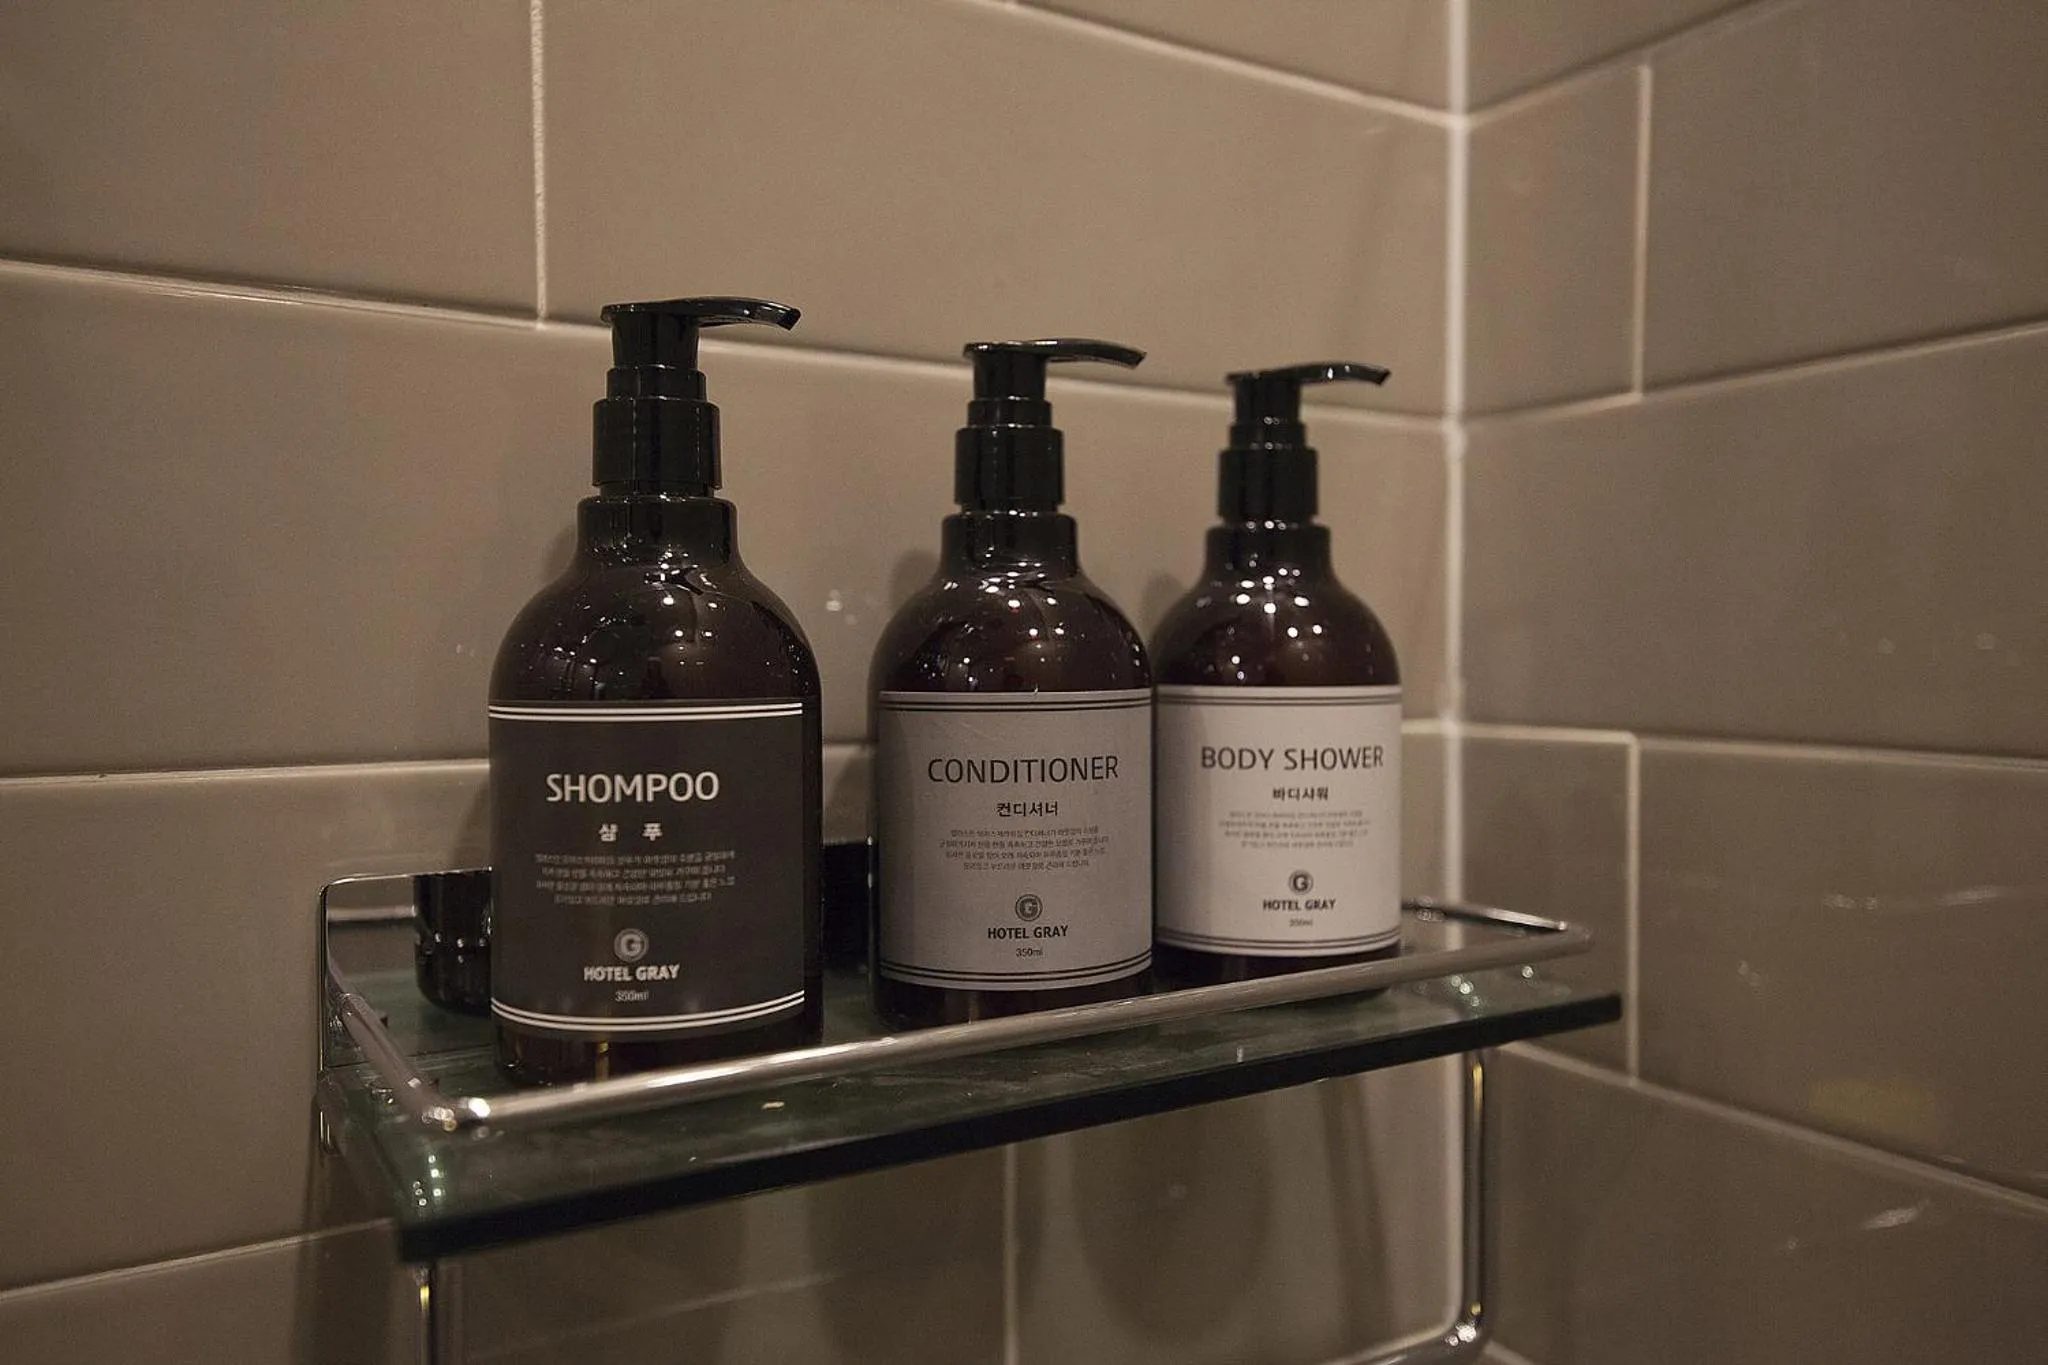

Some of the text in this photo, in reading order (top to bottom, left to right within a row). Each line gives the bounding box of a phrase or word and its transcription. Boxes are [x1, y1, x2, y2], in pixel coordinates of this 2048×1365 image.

[1200, 745, 1384, 771] BODY SHOWER
[927, 755, 1119, 784] CONDITIONER
[546, 771, 719, 803] SHOMPOO
[996, 801, 1058, 818] 컨디셔너
[1262, 898, 1337, 911] HOTEL GRAY
[987, 925, 1069, 940] HOTEL GRAY
[583, 964, 680, 982] HOTEL GRAY
